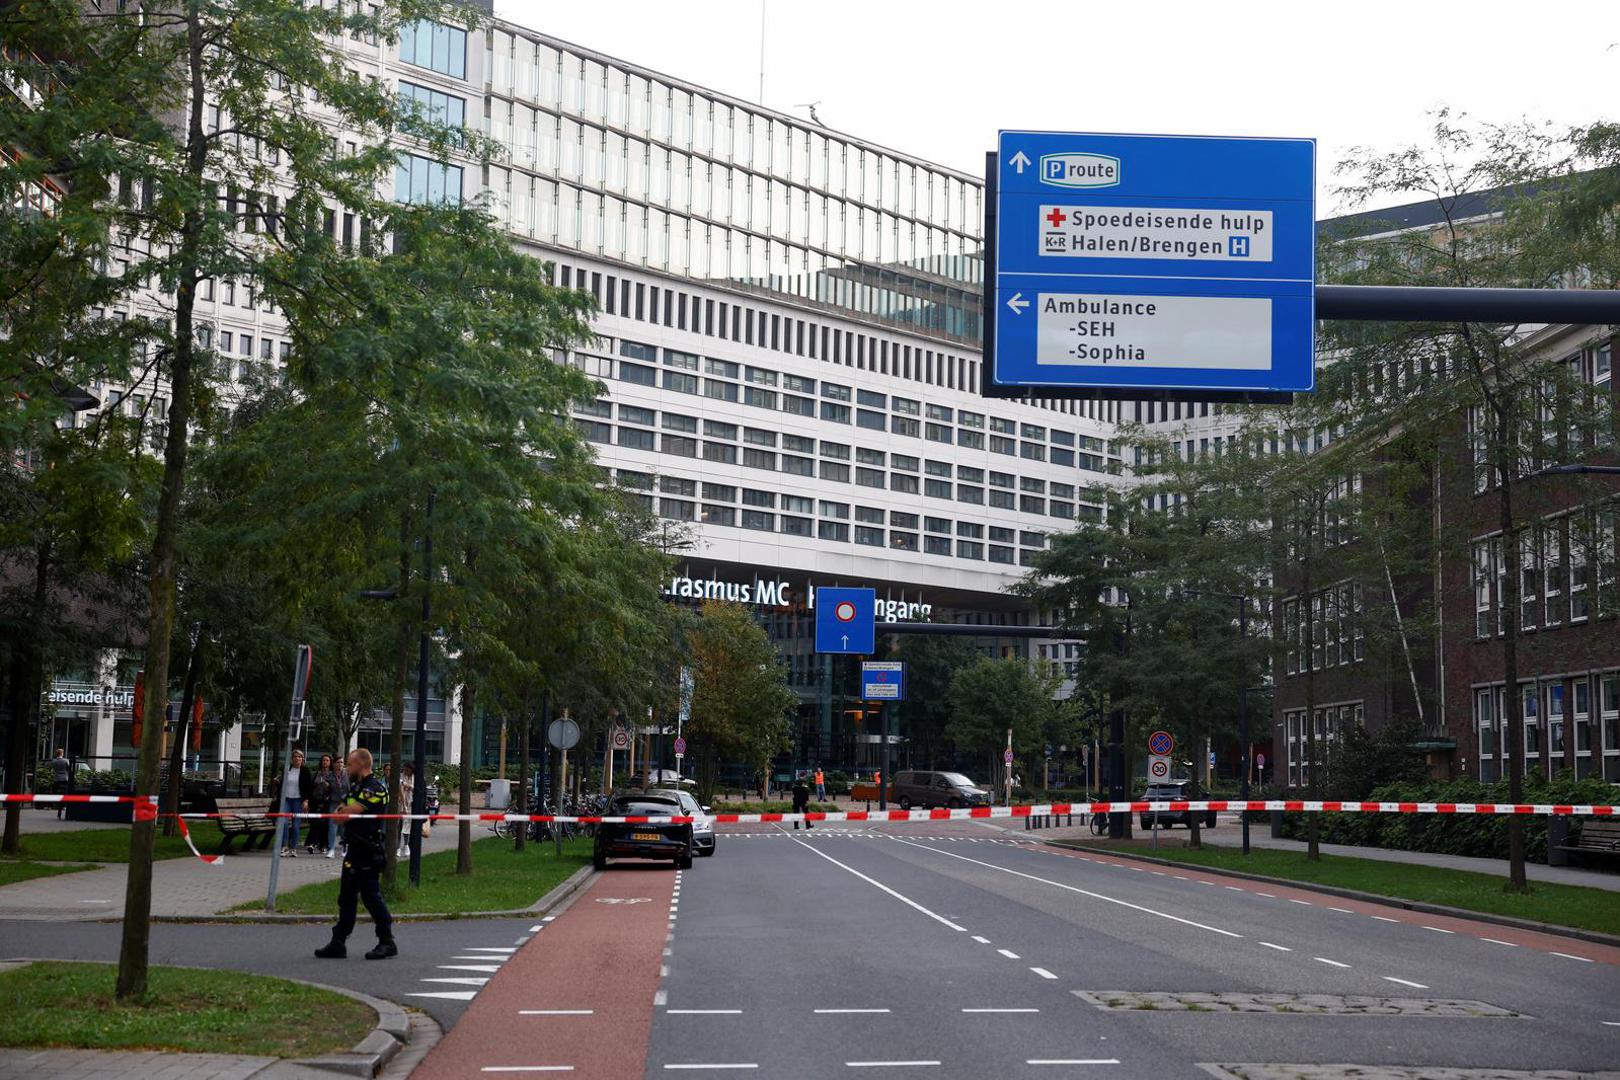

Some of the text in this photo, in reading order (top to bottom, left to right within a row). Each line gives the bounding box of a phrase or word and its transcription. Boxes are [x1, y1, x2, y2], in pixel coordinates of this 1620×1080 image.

[1050, 161, 1114, 178] P route
[1072, 210, 1264, 234] Spoedeisende hulp
[1046, 236, 1246, 257] K+R Halen/Brengen H
[1044, 298, 1156, 316] Ambulance
[1069, 320, 1114, 337] -SEH
[1069, 343, 1145, 363] -Sophia
[756, 579, 790, 607] MC
[48, 690, 102, 704] eisende
